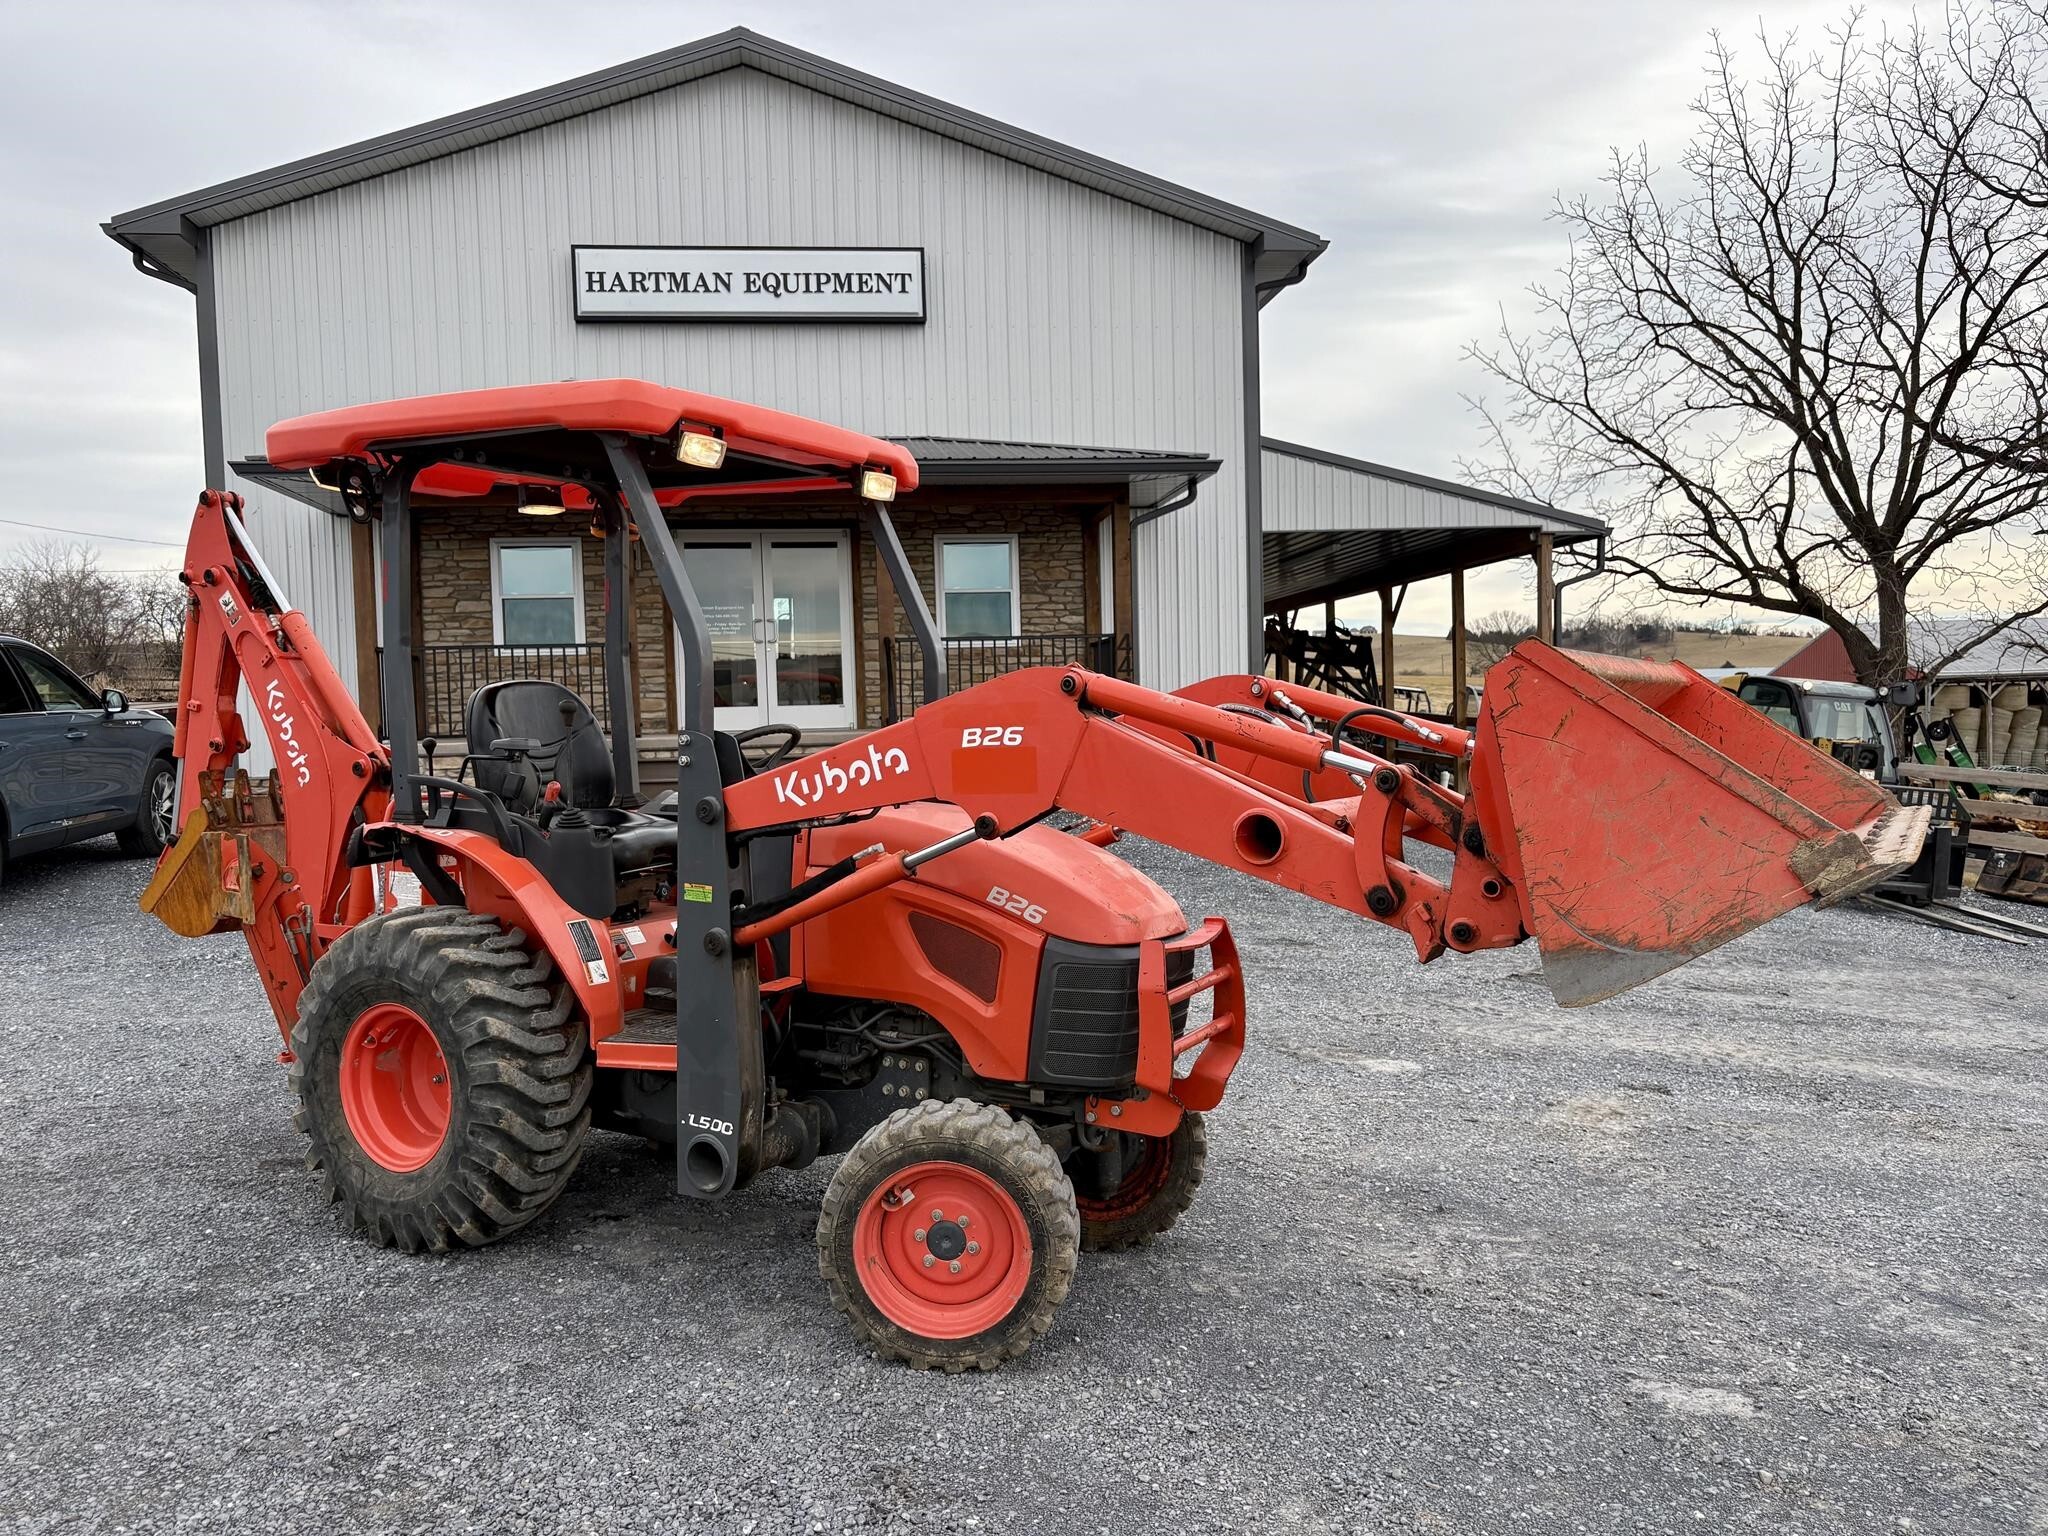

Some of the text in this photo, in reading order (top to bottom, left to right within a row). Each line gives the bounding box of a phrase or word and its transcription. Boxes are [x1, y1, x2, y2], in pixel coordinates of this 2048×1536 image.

[585, 271, 913, 298] HARTMAN EQUIPMENT
[1833, 701, 1853, 712] CAT
[266, 679, 311, 788] Kubota
[961, 726, 1025, 748] B26
[774, 743, 910, 807] Kubota
[986, 886, 1048, 924] B26
